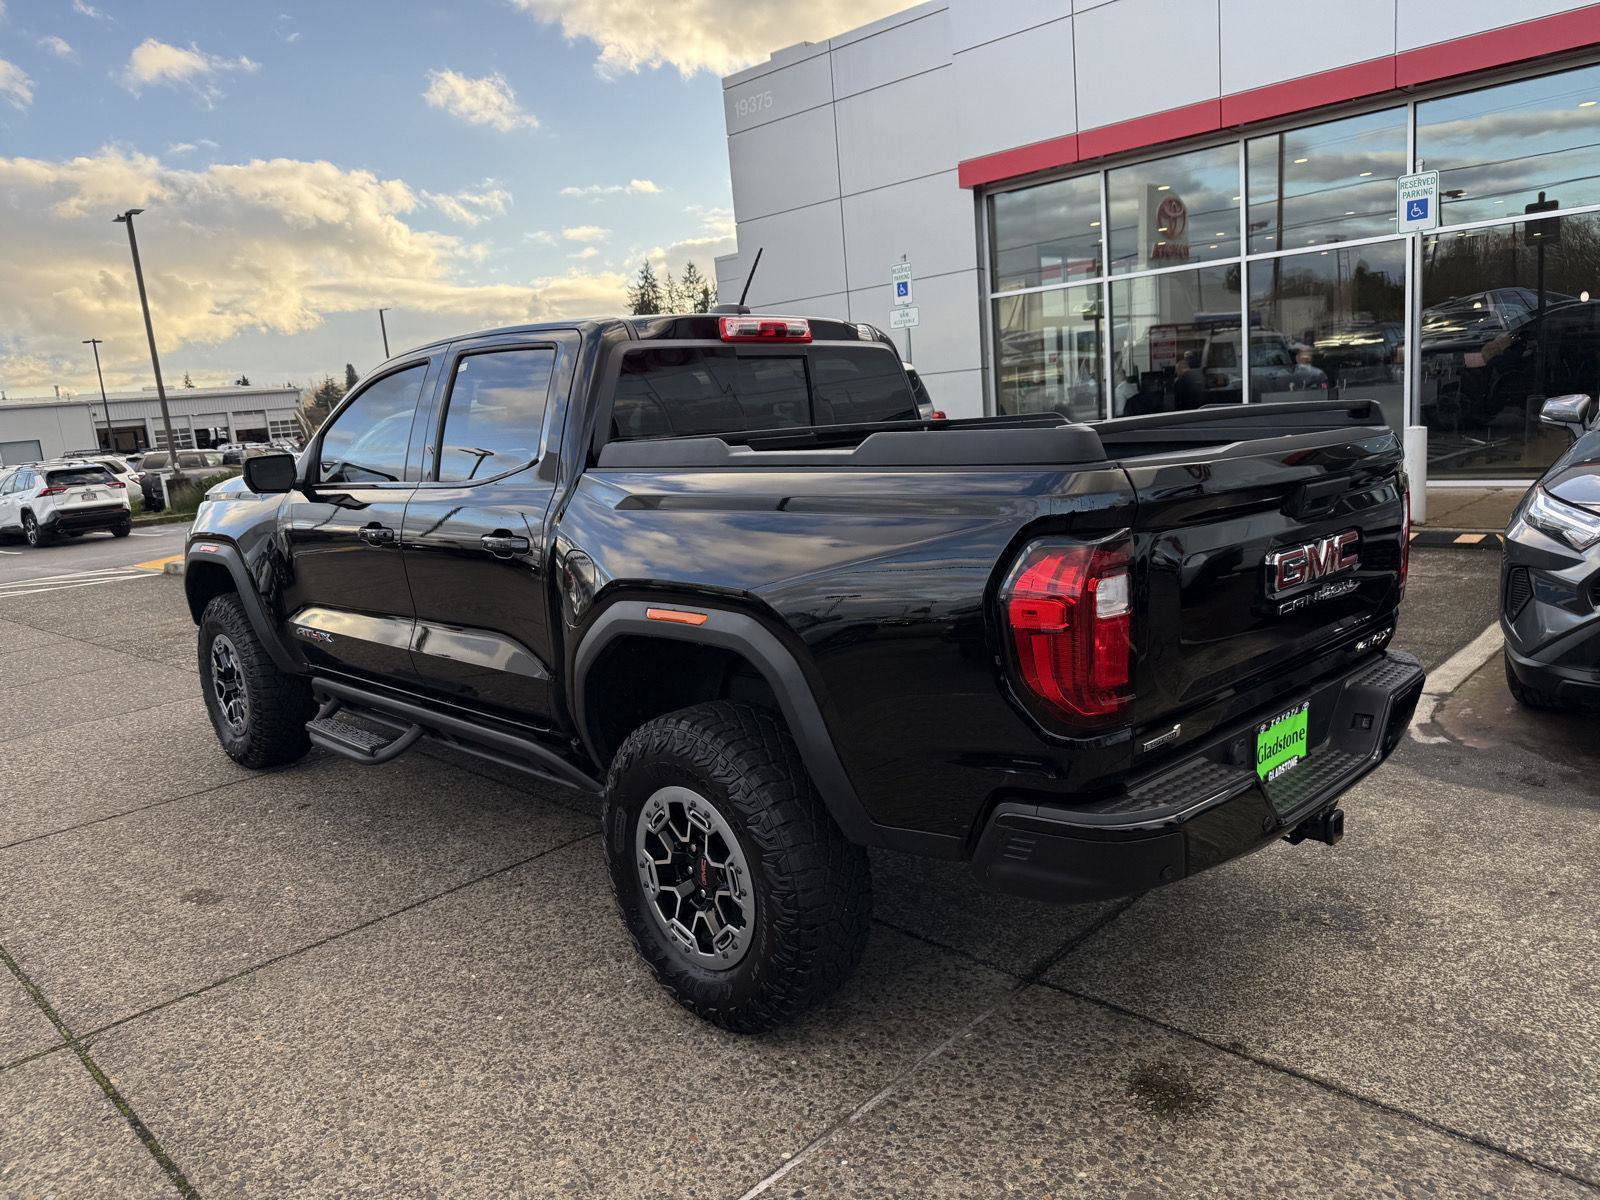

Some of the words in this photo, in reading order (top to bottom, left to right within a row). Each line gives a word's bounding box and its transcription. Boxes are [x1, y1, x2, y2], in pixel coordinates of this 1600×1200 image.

[735, 91, 772, 117] 19375
[1401, 177, 1436, 190] RESERVED
[1403, 188, 1433, 199] PARKING
[1265, 531, 1359, 599] GMC
[1257, 727, 1305, 764] Gladstone
[1268, 755, 1299, 781] GLADSTONE
